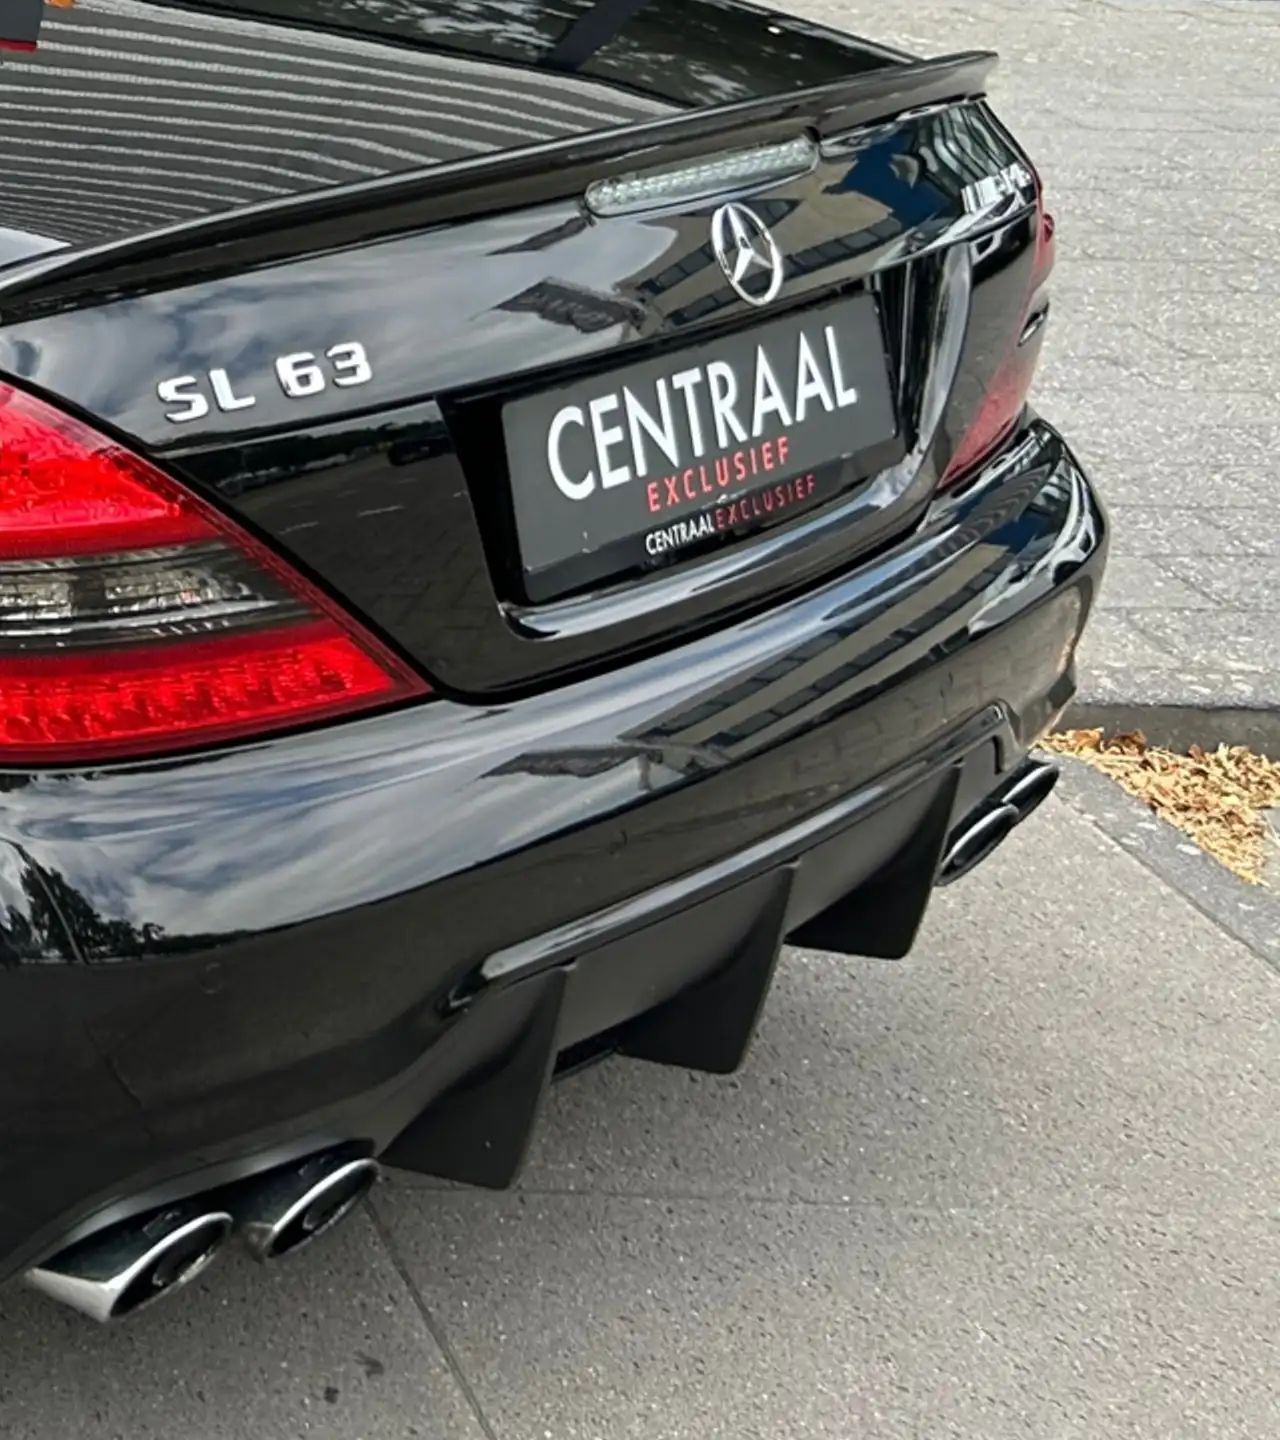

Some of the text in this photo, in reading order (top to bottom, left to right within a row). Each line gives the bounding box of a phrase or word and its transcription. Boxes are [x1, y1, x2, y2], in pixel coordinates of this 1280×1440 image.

[157, 340, 373, 423] SL 63
[547, 325, 858, 501] CENTRAAL
[646, 435, 790, 513] EXCLUSIEF
